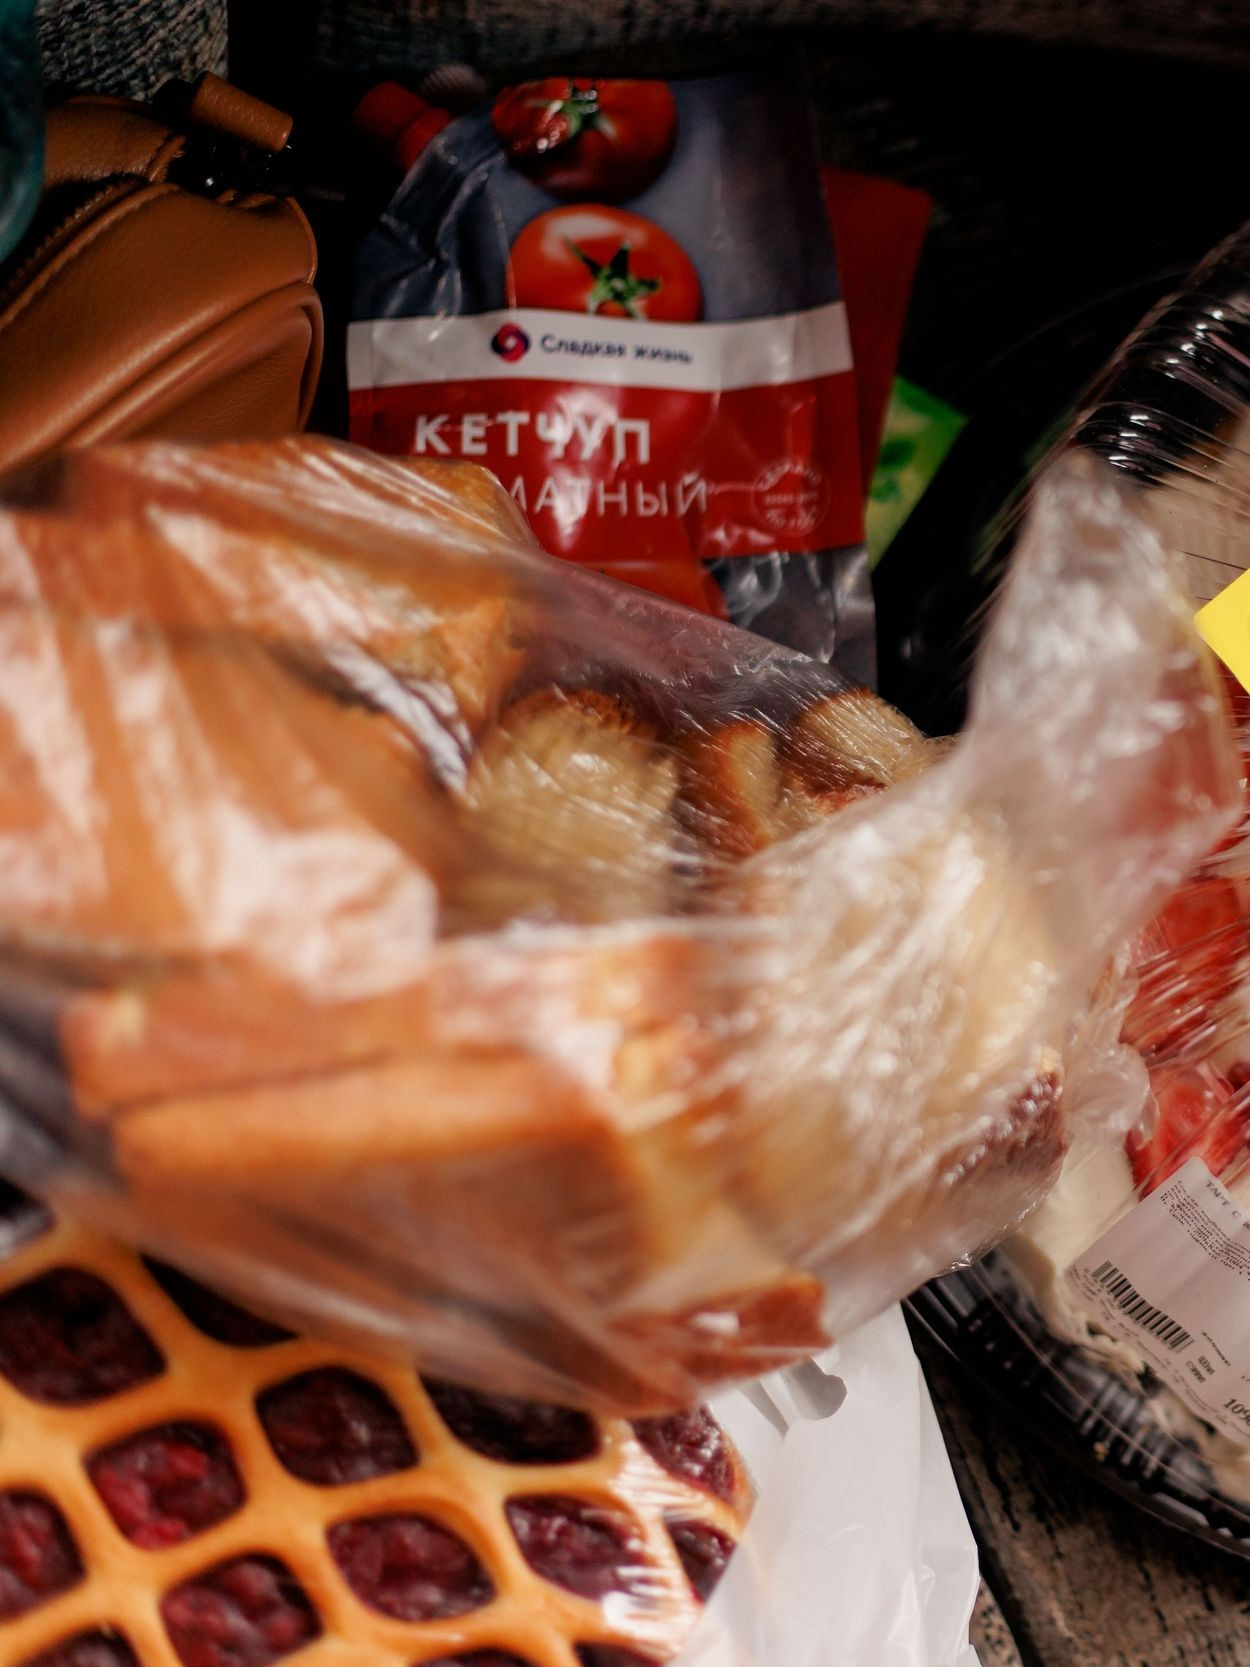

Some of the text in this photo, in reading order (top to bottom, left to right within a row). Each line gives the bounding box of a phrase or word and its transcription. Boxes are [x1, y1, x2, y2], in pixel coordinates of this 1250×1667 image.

[539, 334, 693, 364] Сладкая жизнь
[414, 409, 651, 465] КЕТЧУП
